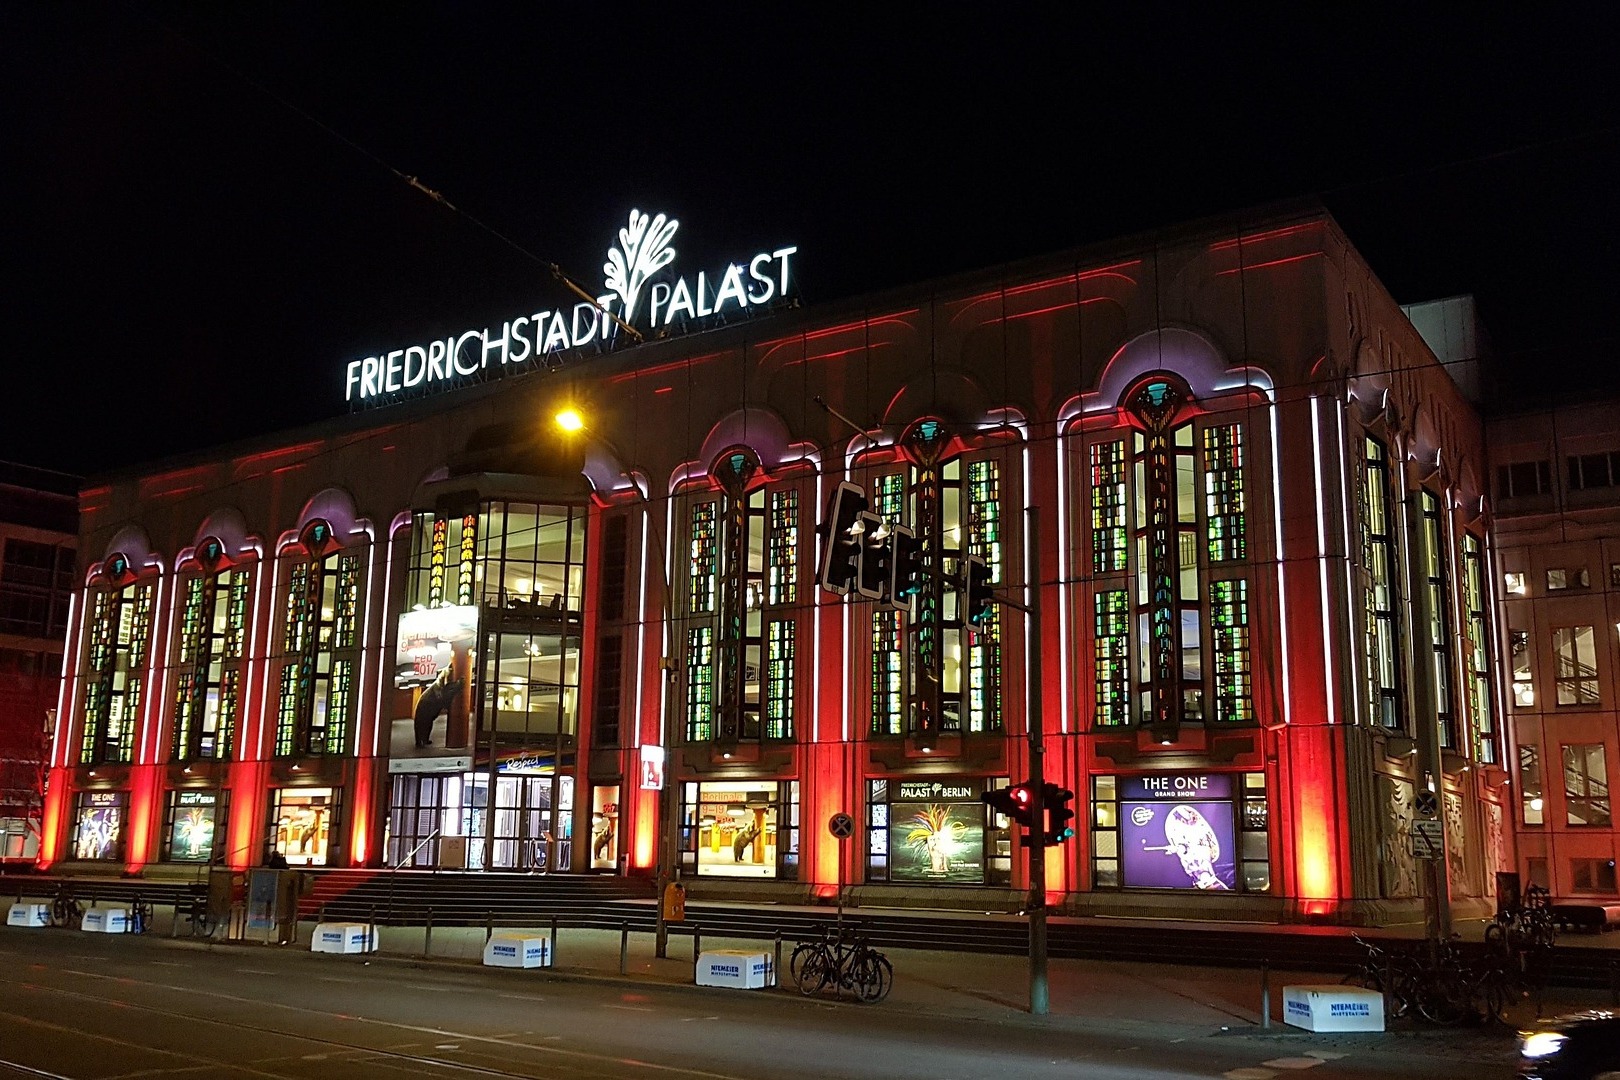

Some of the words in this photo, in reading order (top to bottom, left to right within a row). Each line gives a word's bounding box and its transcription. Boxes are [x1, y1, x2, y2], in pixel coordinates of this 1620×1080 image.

[345, 292, 617, 401] FRIEDRICHSTADT
[649, 246, 797, 328] PALAST
[414, 663, 437, 675] 2017
[506, 755, 540, 770] Respect
[1142, 777, 1169, 790] THE
[1174, 776, 1208, 790] ONE
[702, 792, 743, 801] Berlinale
[900, 788, 931, 798] PALAST
[942, 787, 972, 797] BERLIN
[710, 964, 739, 973] NIEMEIER
[1330, 1003, 1369, 1011] NIEMEIER
